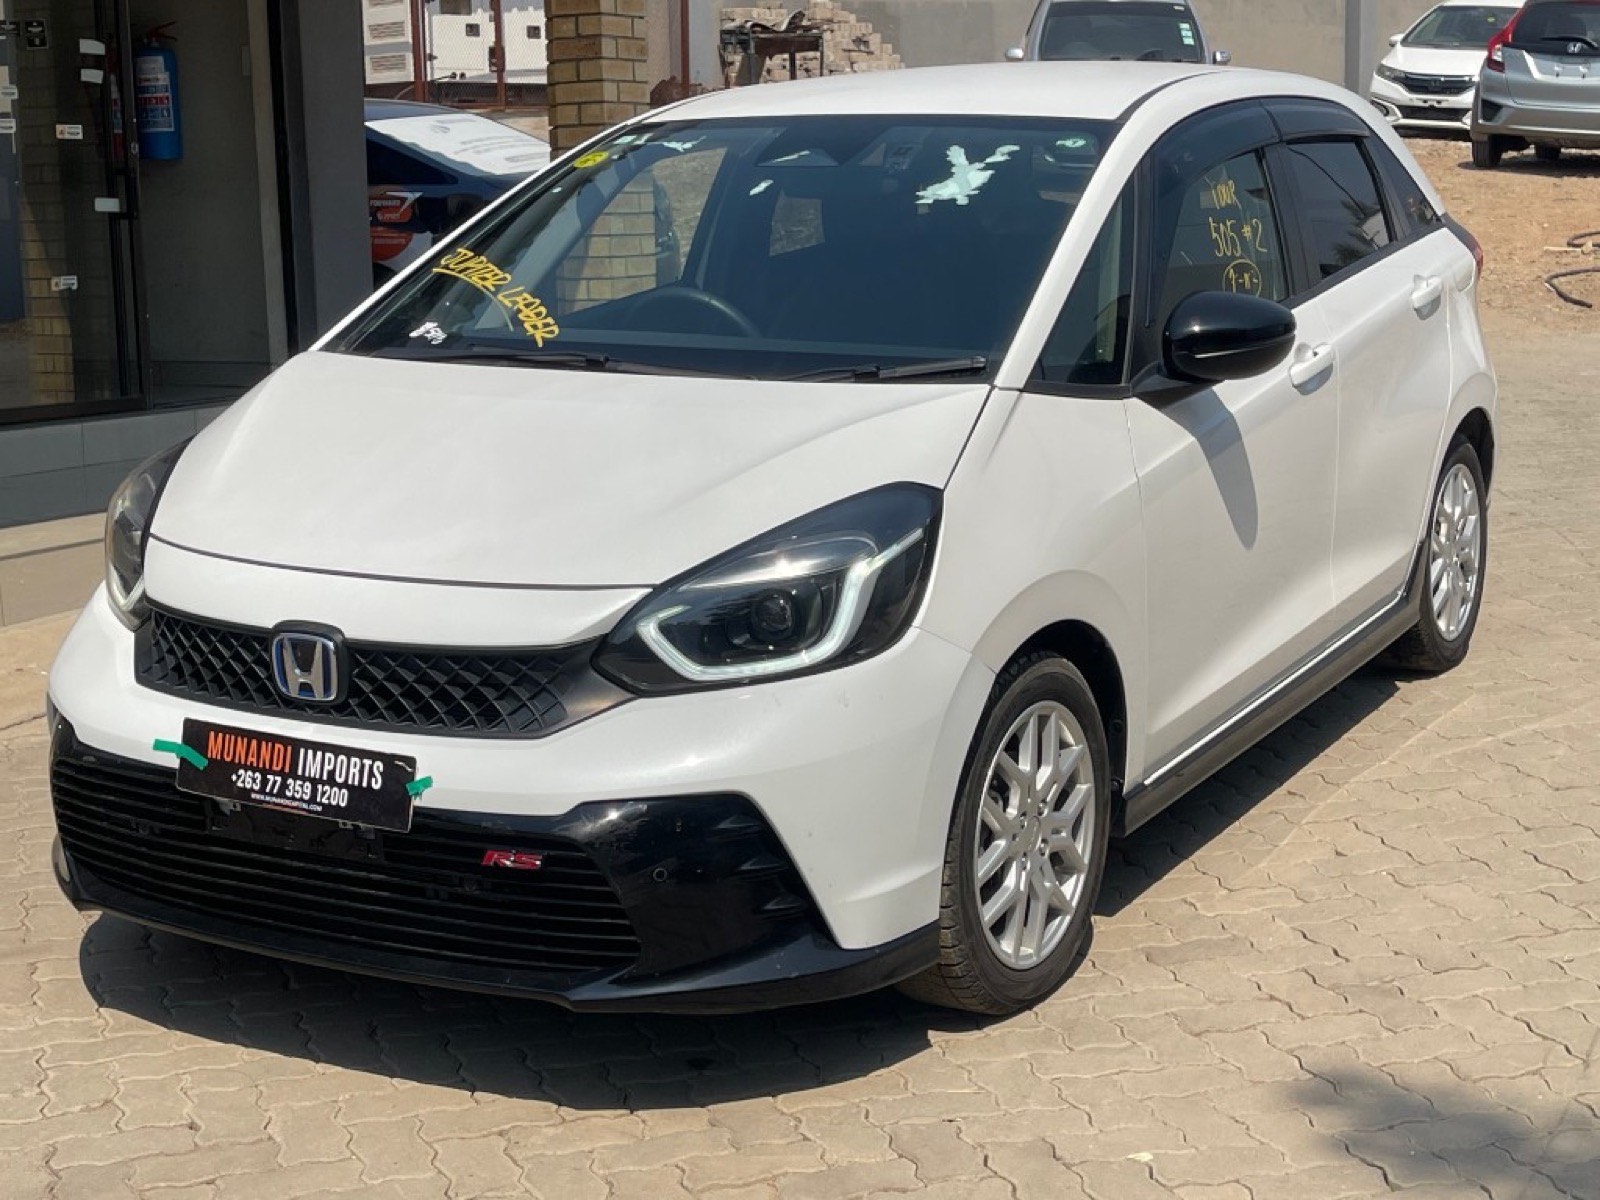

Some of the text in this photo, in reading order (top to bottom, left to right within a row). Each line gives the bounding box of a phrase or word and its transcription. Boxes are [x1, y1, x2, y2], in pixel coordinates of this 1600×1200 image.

[1208, 216, 1242, 257] 505
[441, 248, 512, 291] JUPITER
[497, 286, 560, 348] LEADER
[207, 730, 384, 790] MUNANDI IMPORTS
[230, 768, 349, 807] +263 77 359 1200
[481, 850, 543, 870] RS
